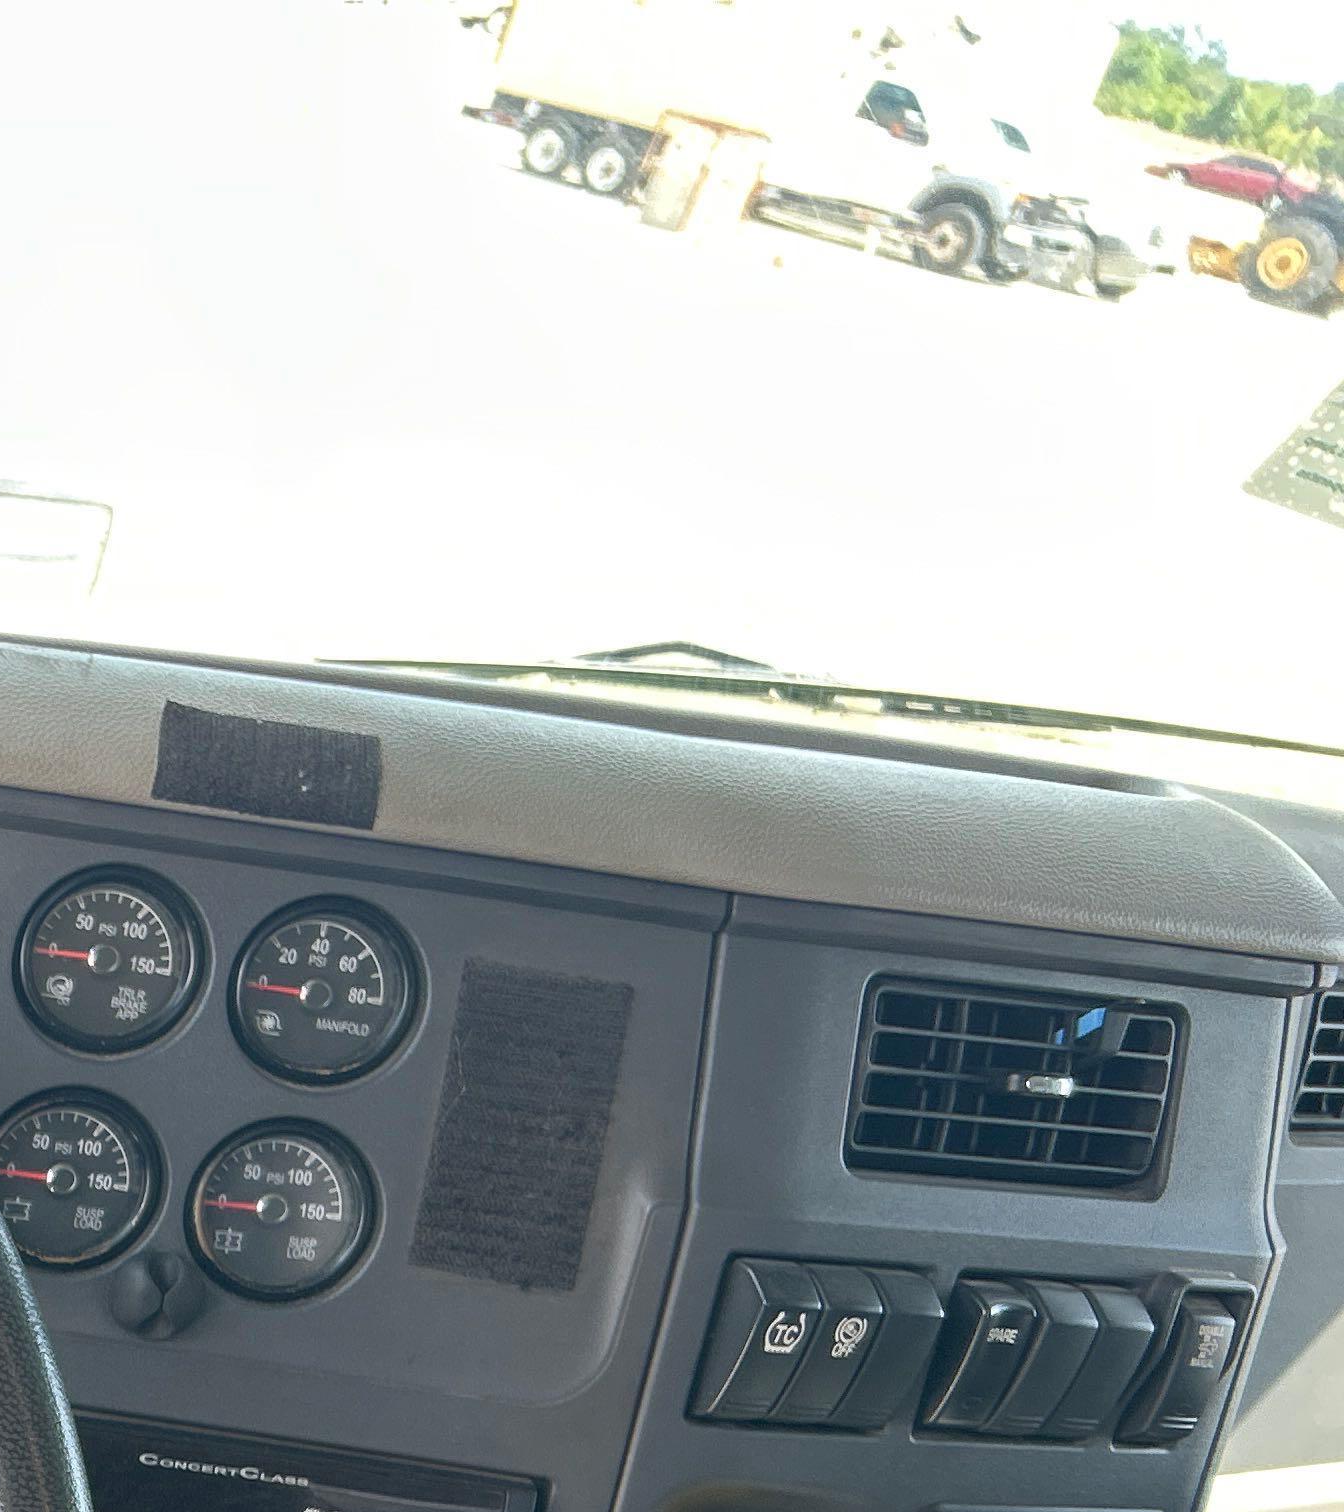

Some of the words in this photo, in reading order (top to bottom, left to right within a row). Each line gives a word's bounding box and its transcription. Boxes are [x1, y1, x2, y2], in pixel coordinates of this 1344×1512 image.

[75, 913, 94, 931] 50
[98, 922, 117, 937] PSI
[122, 920, 148, 940] 100
[278, 946, 297, 965] 20
[311, 938, 330, 955] 40
[130, 956, 155, 975] 150
[339, 954, 357, 973] 60
[347, 986, 366, 1005] 80
[315, 1017, 369, 1037] MANIFOLD
[31, 1133, 50, 1150] 50
[77, 1138, 102, 1157] 100
[87, 1172, 112, 1191] 150
[243, 1163, 261, 1181] 50
[287, 1167, 312, 1186] 100
[75, 1205, 105, 1220] SUSP
[299, 1202, 325, 1221] 150
[73, 1216, 102, 1231] LOAD
[286, 1247, 316, 1262] LOAD
[772, 1324, 799, 1344] TC
[986, 1326, 1019, 1345] SPARE
[831, 1342, 854, 1358] OFF
